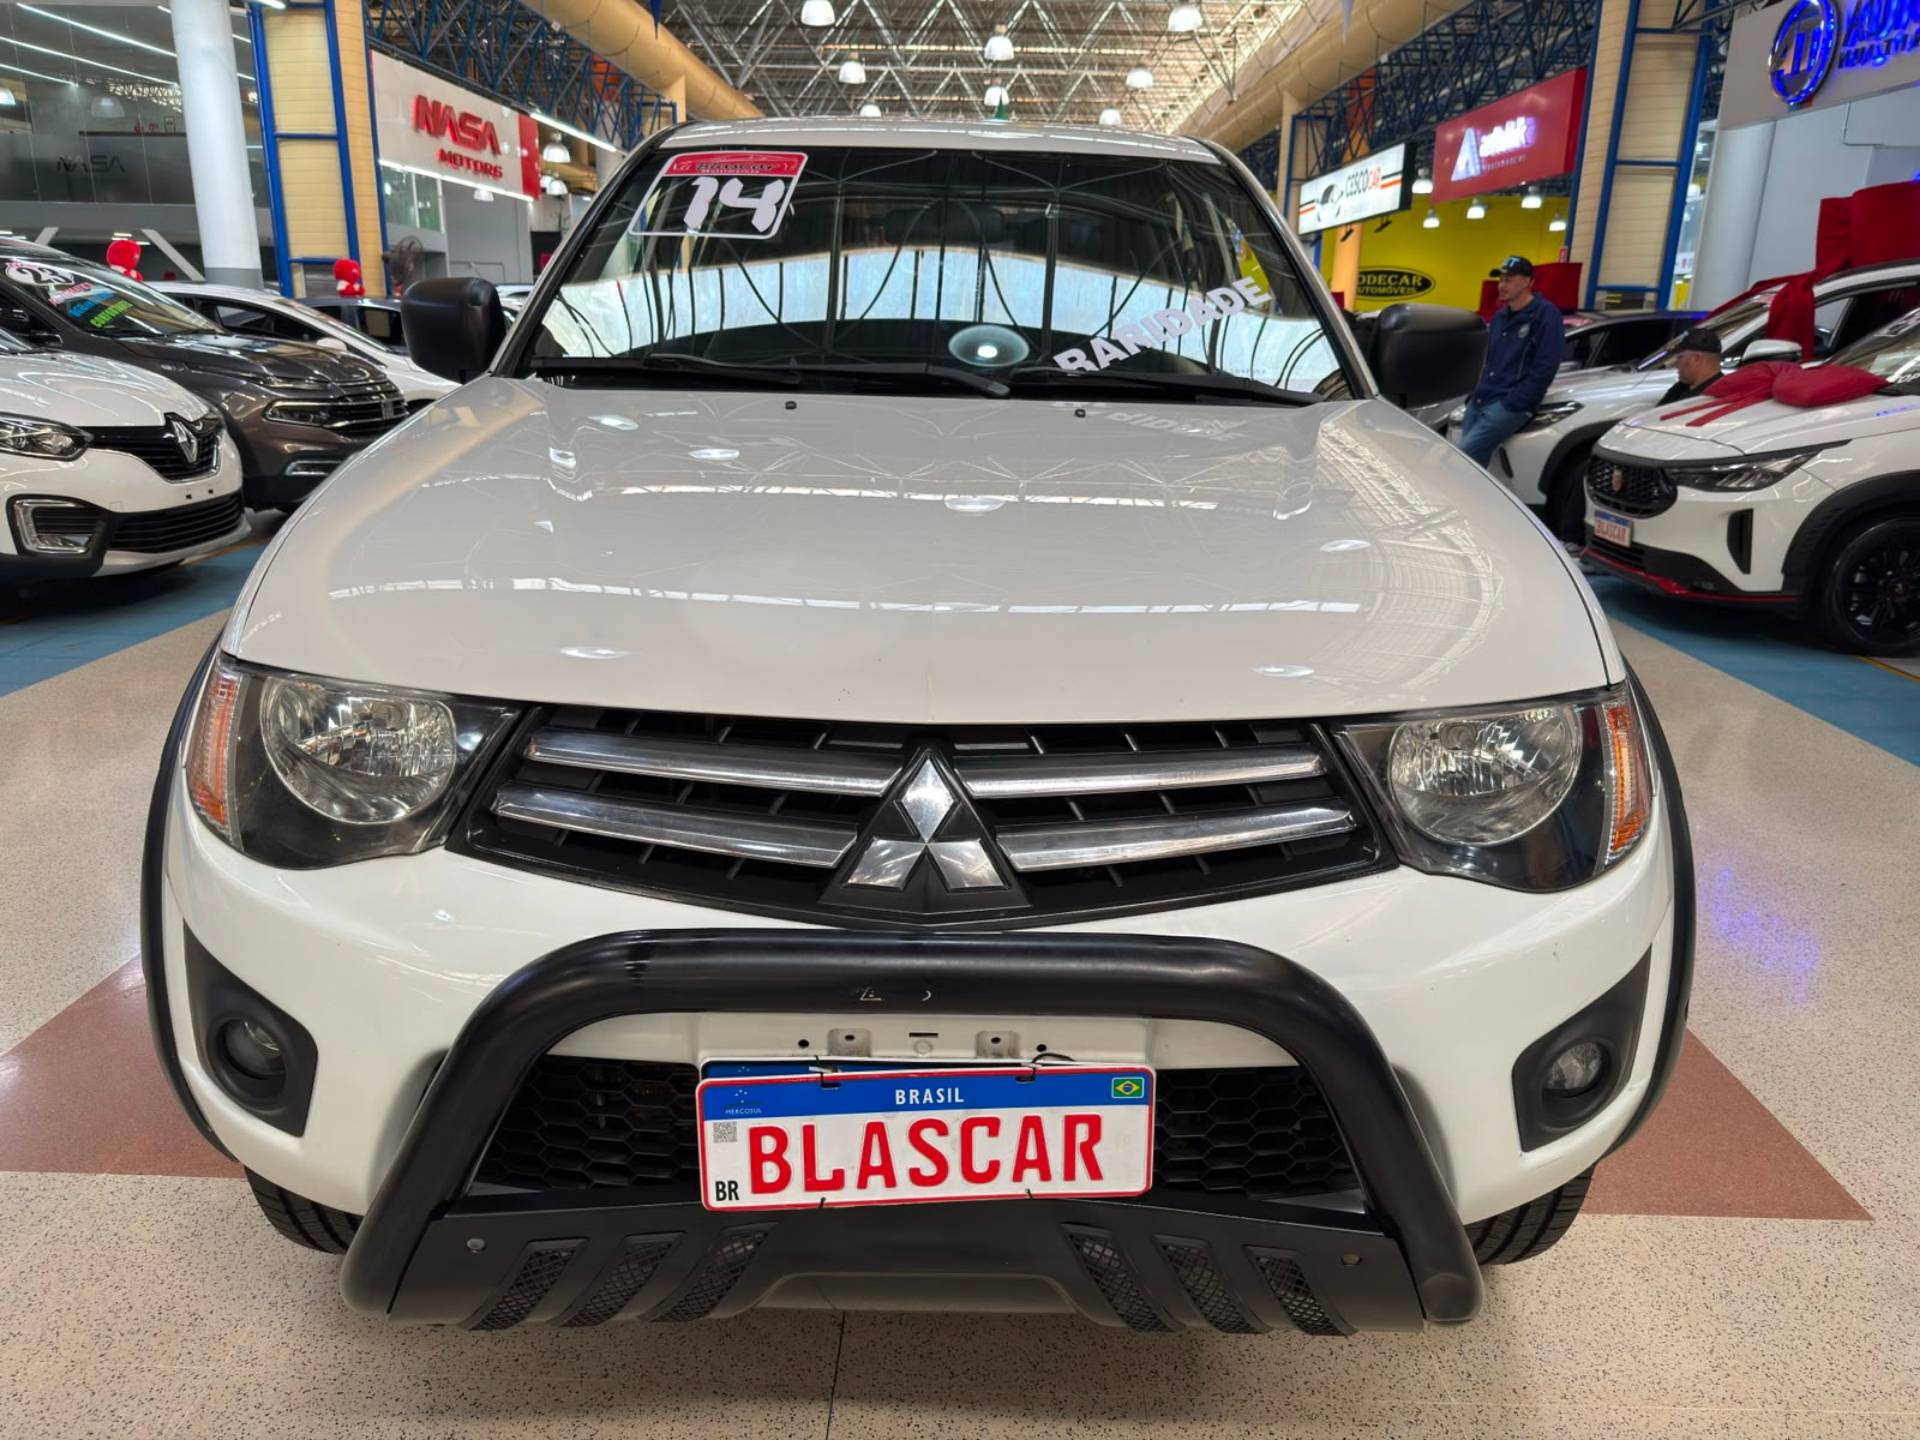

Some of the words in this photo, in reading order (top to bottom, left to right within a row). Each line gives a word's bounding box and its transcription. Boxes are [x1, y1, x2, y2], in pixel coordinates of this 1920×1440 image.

[412, 94, 502, 156] NASA
[435, 149, 503, 181] MOTORS
[1345, 167, 1382, 197] CESCOCAR
[683, 176, 786, 233] 14
[16, 266, 73, 284] 23
[1358, 273, 1422, 287] ODECAR
[1357, 285, 1417, 295] UTOMÓVEIS
[1053, 276, 1272, 372] RARIDADE
[895, 1087, 965, 1105] BRASIL
[724, 1107, 762, 1115] MERCOSUL
[748, 1114, 1104, 1195] BLASCAR
[714, 1180, 740, 1201] BR
